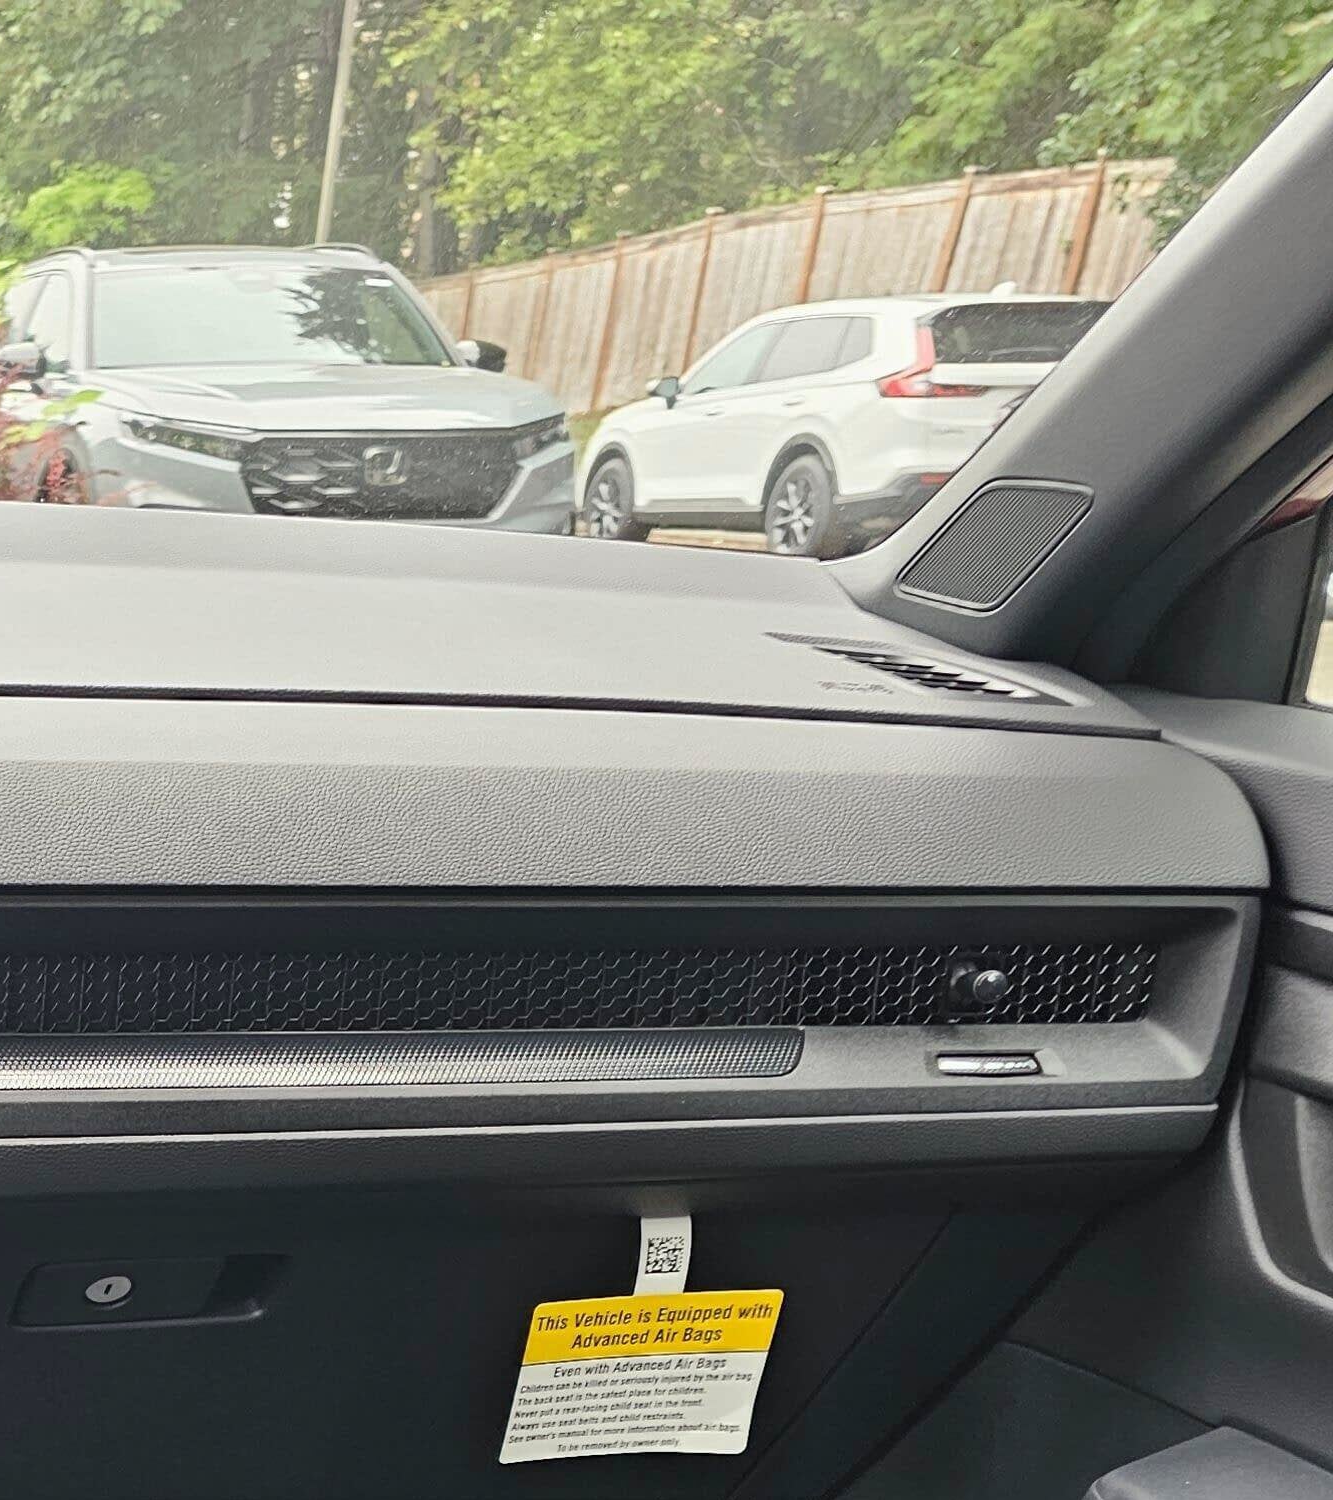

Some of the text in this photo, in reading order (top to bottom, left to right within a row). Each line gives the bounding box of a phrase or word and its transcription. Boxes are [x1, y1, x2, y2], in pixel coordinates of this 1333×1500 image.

[537, 1303, 773, 1332] This Vehicle is Equipped with
[571, 1327, 723, 1350] Advanced Air Bags
[554, 1357, 727, 1378] Even with Advanced Air Bags
[520, 1384, 554, 1394] Children
[556, 1383, 571, 1391] can
[573, 1381, 583, 1389] be
[621, 1375, 659, 1386] seriously
[694, 1373, 705, 1383] by
[518, 1398, 532, 1407] The
[584, 1391, 599, 1401] the
[628, 1388, 652, 1398] place
[653, 1387, 666, 1397] for
[514, 1411, 538, 1420] Never
[539, 1408, 554, 1418] put
[610, 1401, 633, 1411] child
[633, 1400, 653, 1410] seat
[665, 1399, 679, 1408] the
[511, 1422, 540, 1432] Always
[601, 1415, 618, 1424] and
[619, 1413, 642, 1423] child
[508, 1435, 524, 1444] See
[590, 1428, 602, 1437] for
[557, 1443, 568, 1453] To
[581, 1440, 620, 1451] removed
